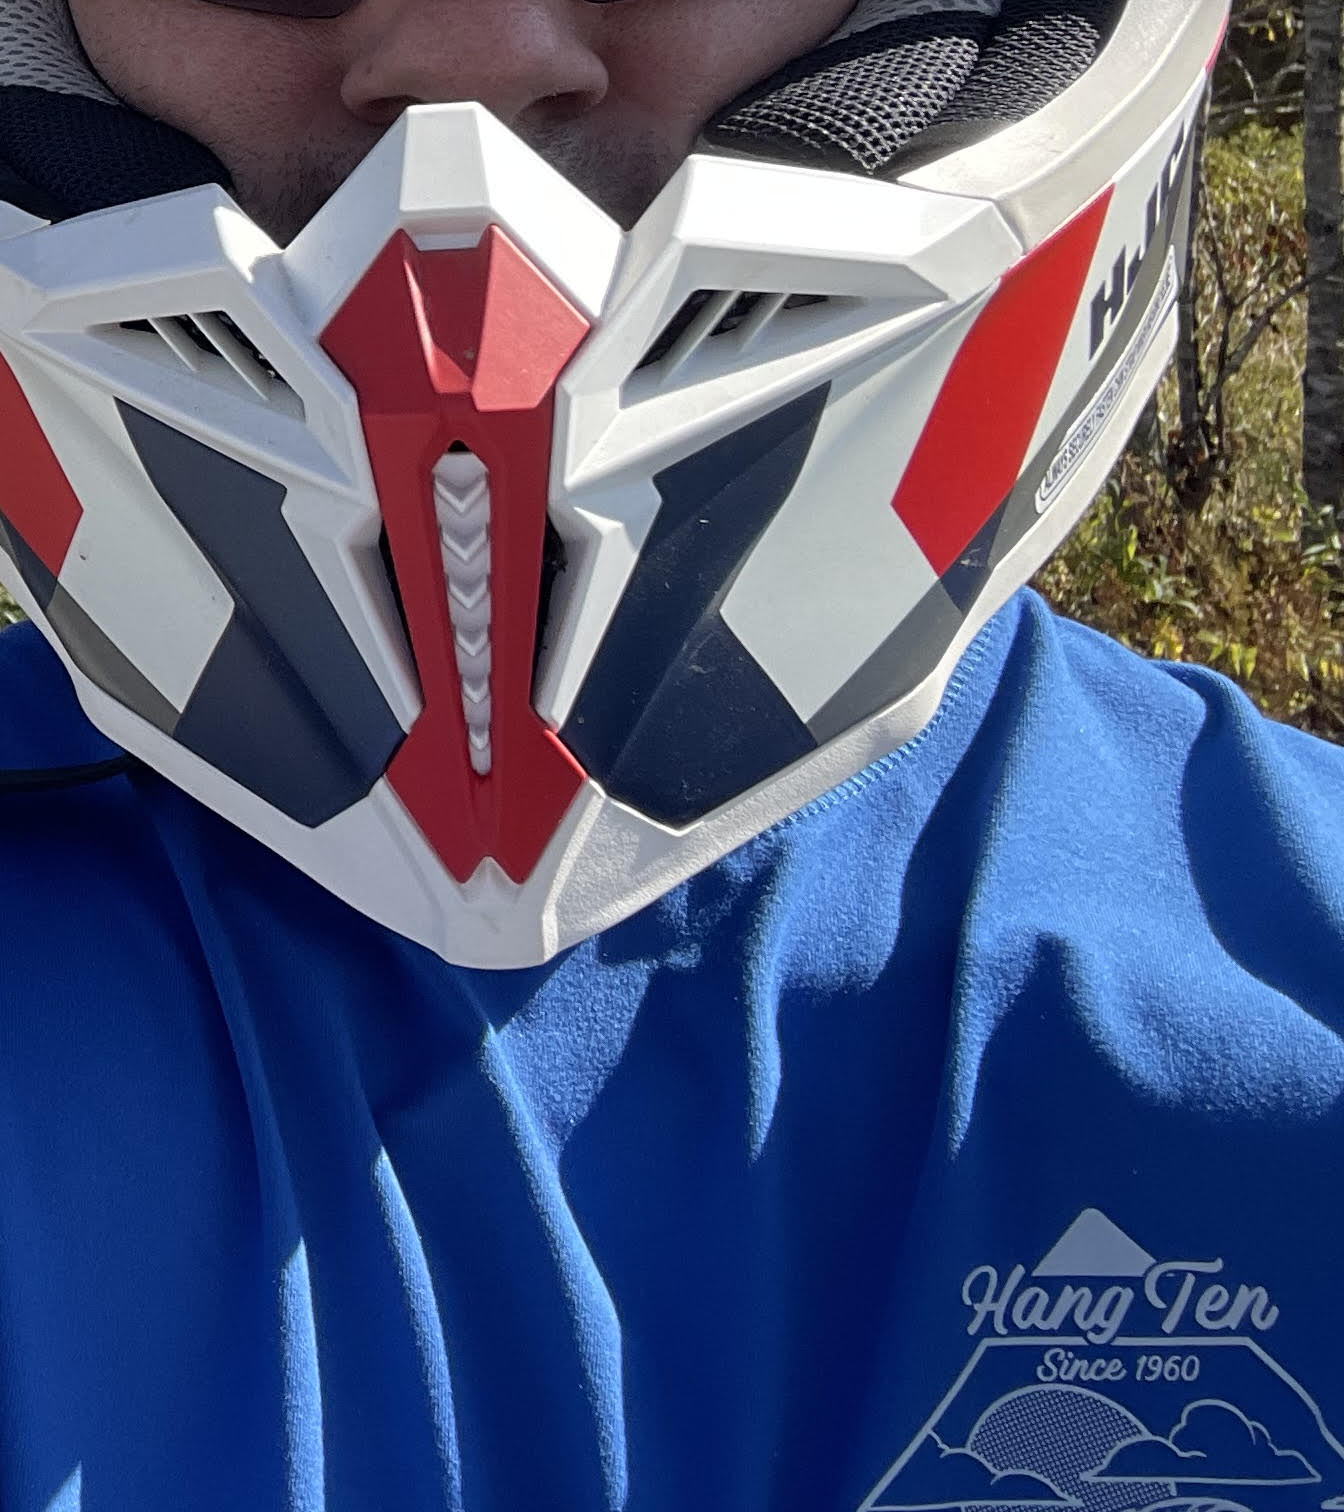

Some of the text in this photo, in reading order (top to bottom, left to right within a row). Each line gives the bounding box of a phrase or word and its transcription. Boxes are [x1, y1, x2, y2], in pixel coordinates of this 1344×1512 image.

[962, 1257, 1280, 1345] Hang Ten
[1036, 1348, 1200, 1382] Since 1960
